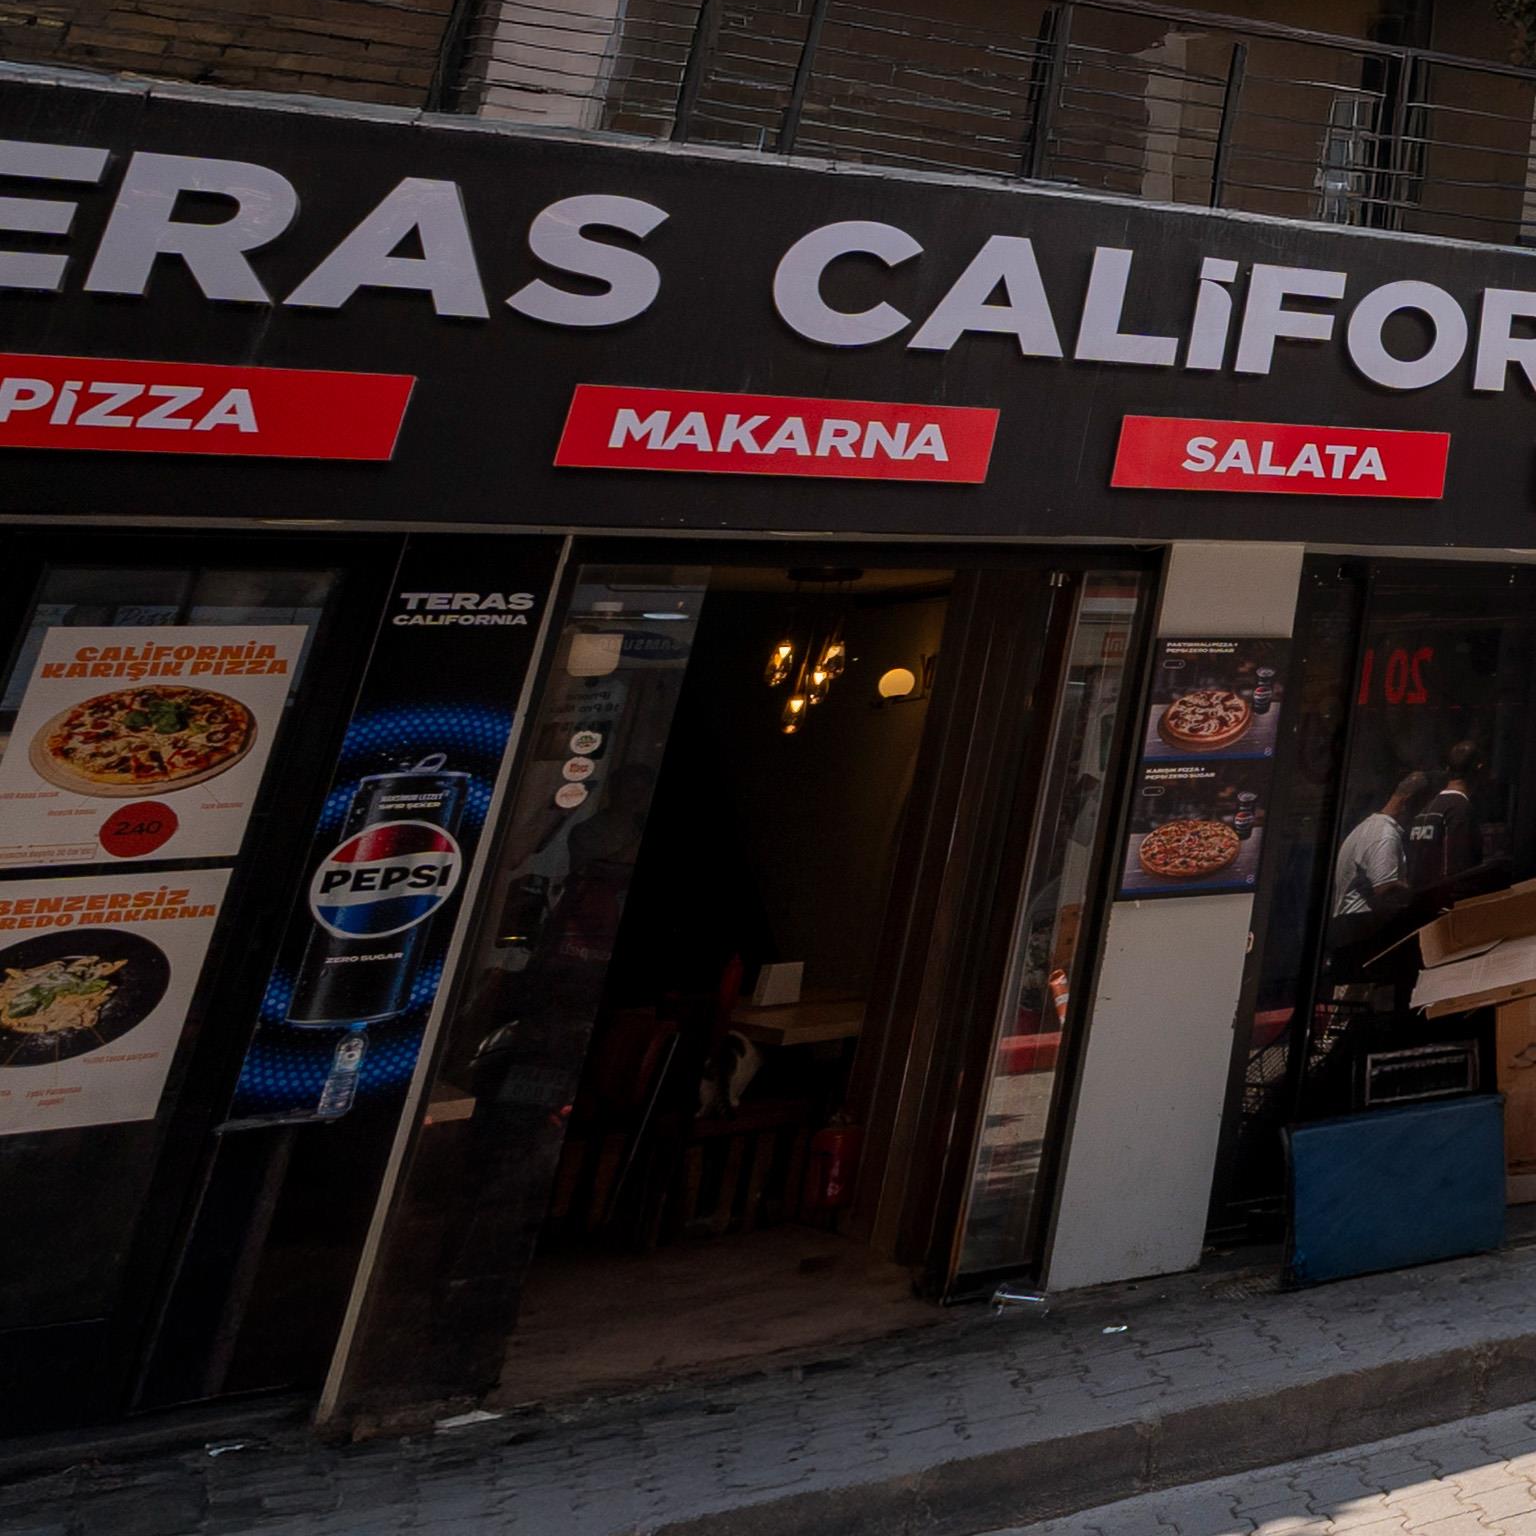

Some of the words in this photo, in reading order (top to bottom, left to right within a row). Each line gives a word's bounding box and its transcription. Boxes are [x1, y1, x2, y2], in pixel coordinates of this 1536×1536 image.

[608, 408, 949, 463] MAKARNA
[1181, 437, 1388, 482] SALATA
[400, 592, 536, 610] TERAS
[391, 613, 528, 626] CALIFORNIA
[41, 661, 182, 681] KARIŞIK
[113, 820, 163, 836] 240
[320, 864, 454, 894] PEPSI
[78, 904, 217, 926] MAKARNA
[324, 955, 359, 965] ZERO
[361, 952, 404, 962] SUGAR
